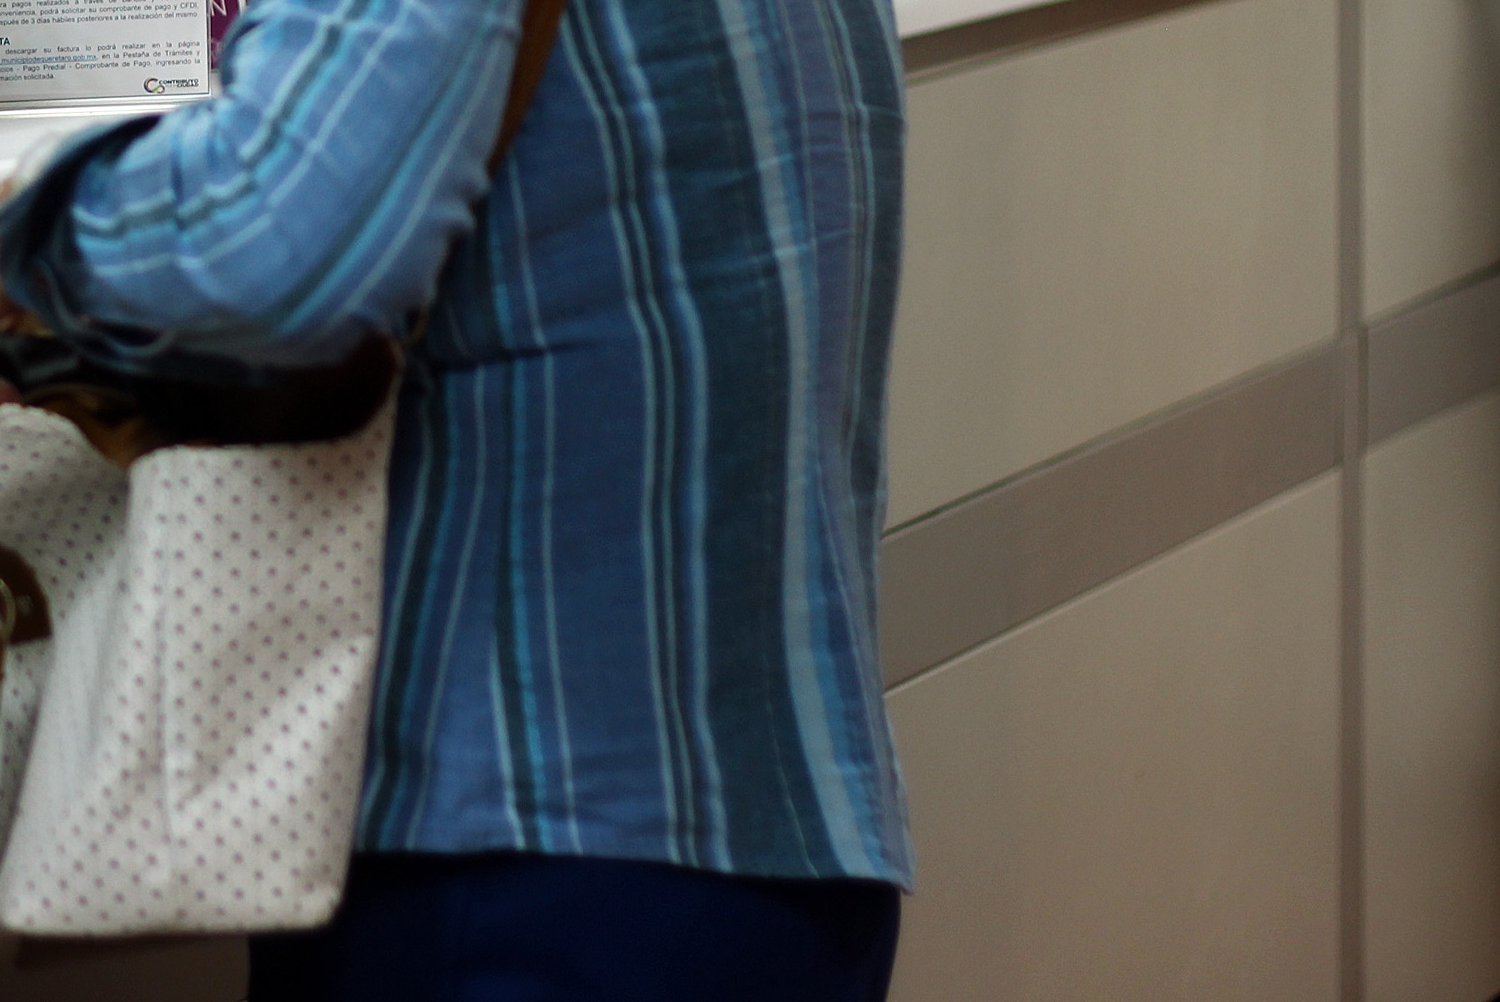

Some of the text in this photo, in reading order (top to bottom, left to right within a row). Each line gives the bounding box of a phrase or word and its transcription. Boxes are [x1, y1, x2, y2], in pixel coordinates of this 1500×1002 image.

[40, 7, 58, 16] podrá
[181, 1, 197, 9] CFDI,
[98, 43, 116, 52] podrá
[178, 39, 199, 48] página
[23, 64, 40, 73] Pago
